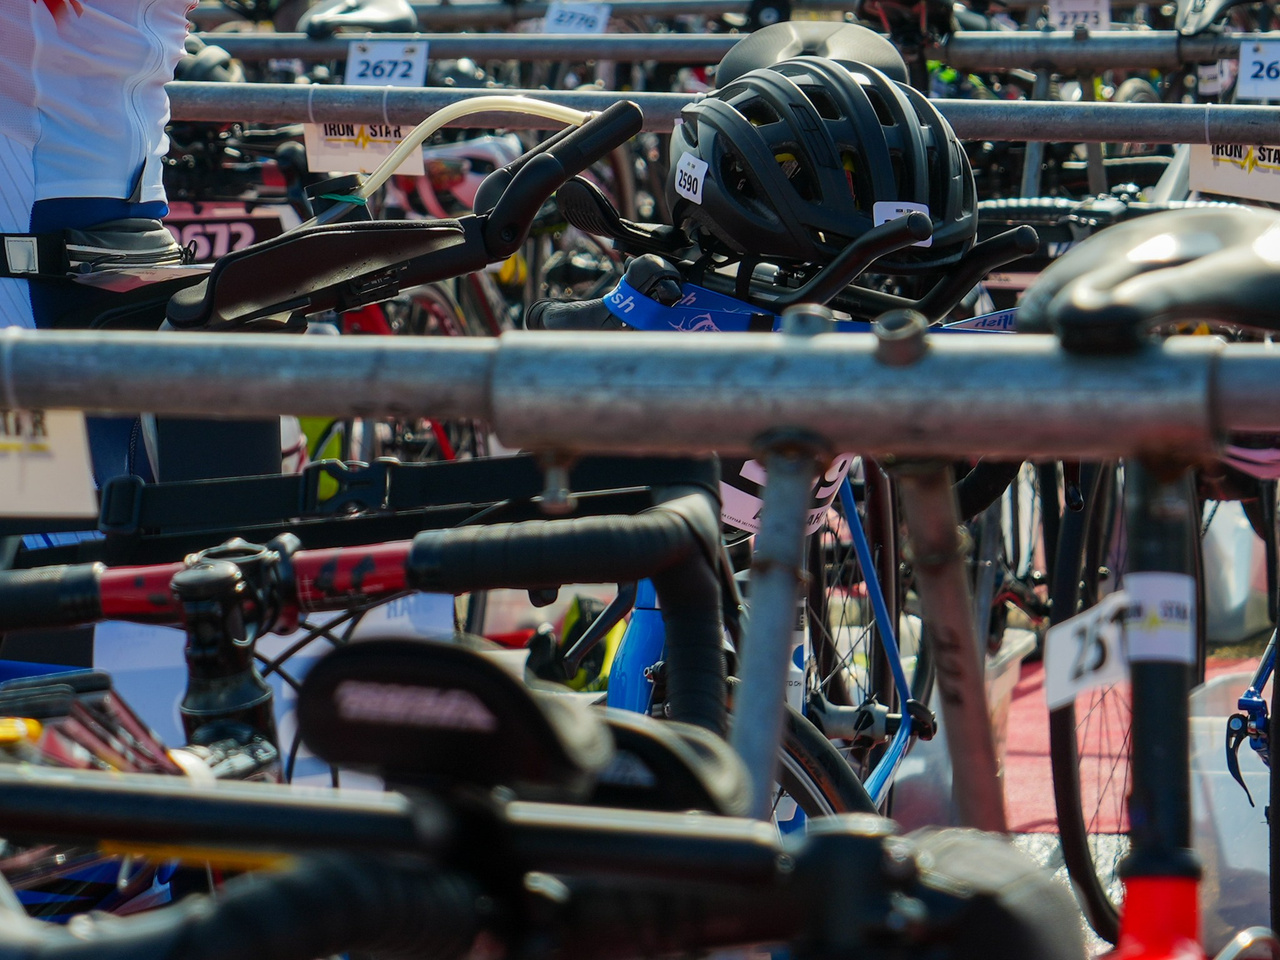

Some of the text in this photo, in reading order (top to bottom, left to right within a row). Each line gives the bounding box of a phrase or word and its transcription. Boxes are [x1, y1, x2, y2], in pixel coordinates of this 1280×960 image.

[358, 59, 413, 79] 2672
[1250, 61, 1280, 79] 26
[324, 124, 402, 138] IRON STAR
[1211, 144, 1243, 158] IRON
[678, 169, 699, 195] 2590
